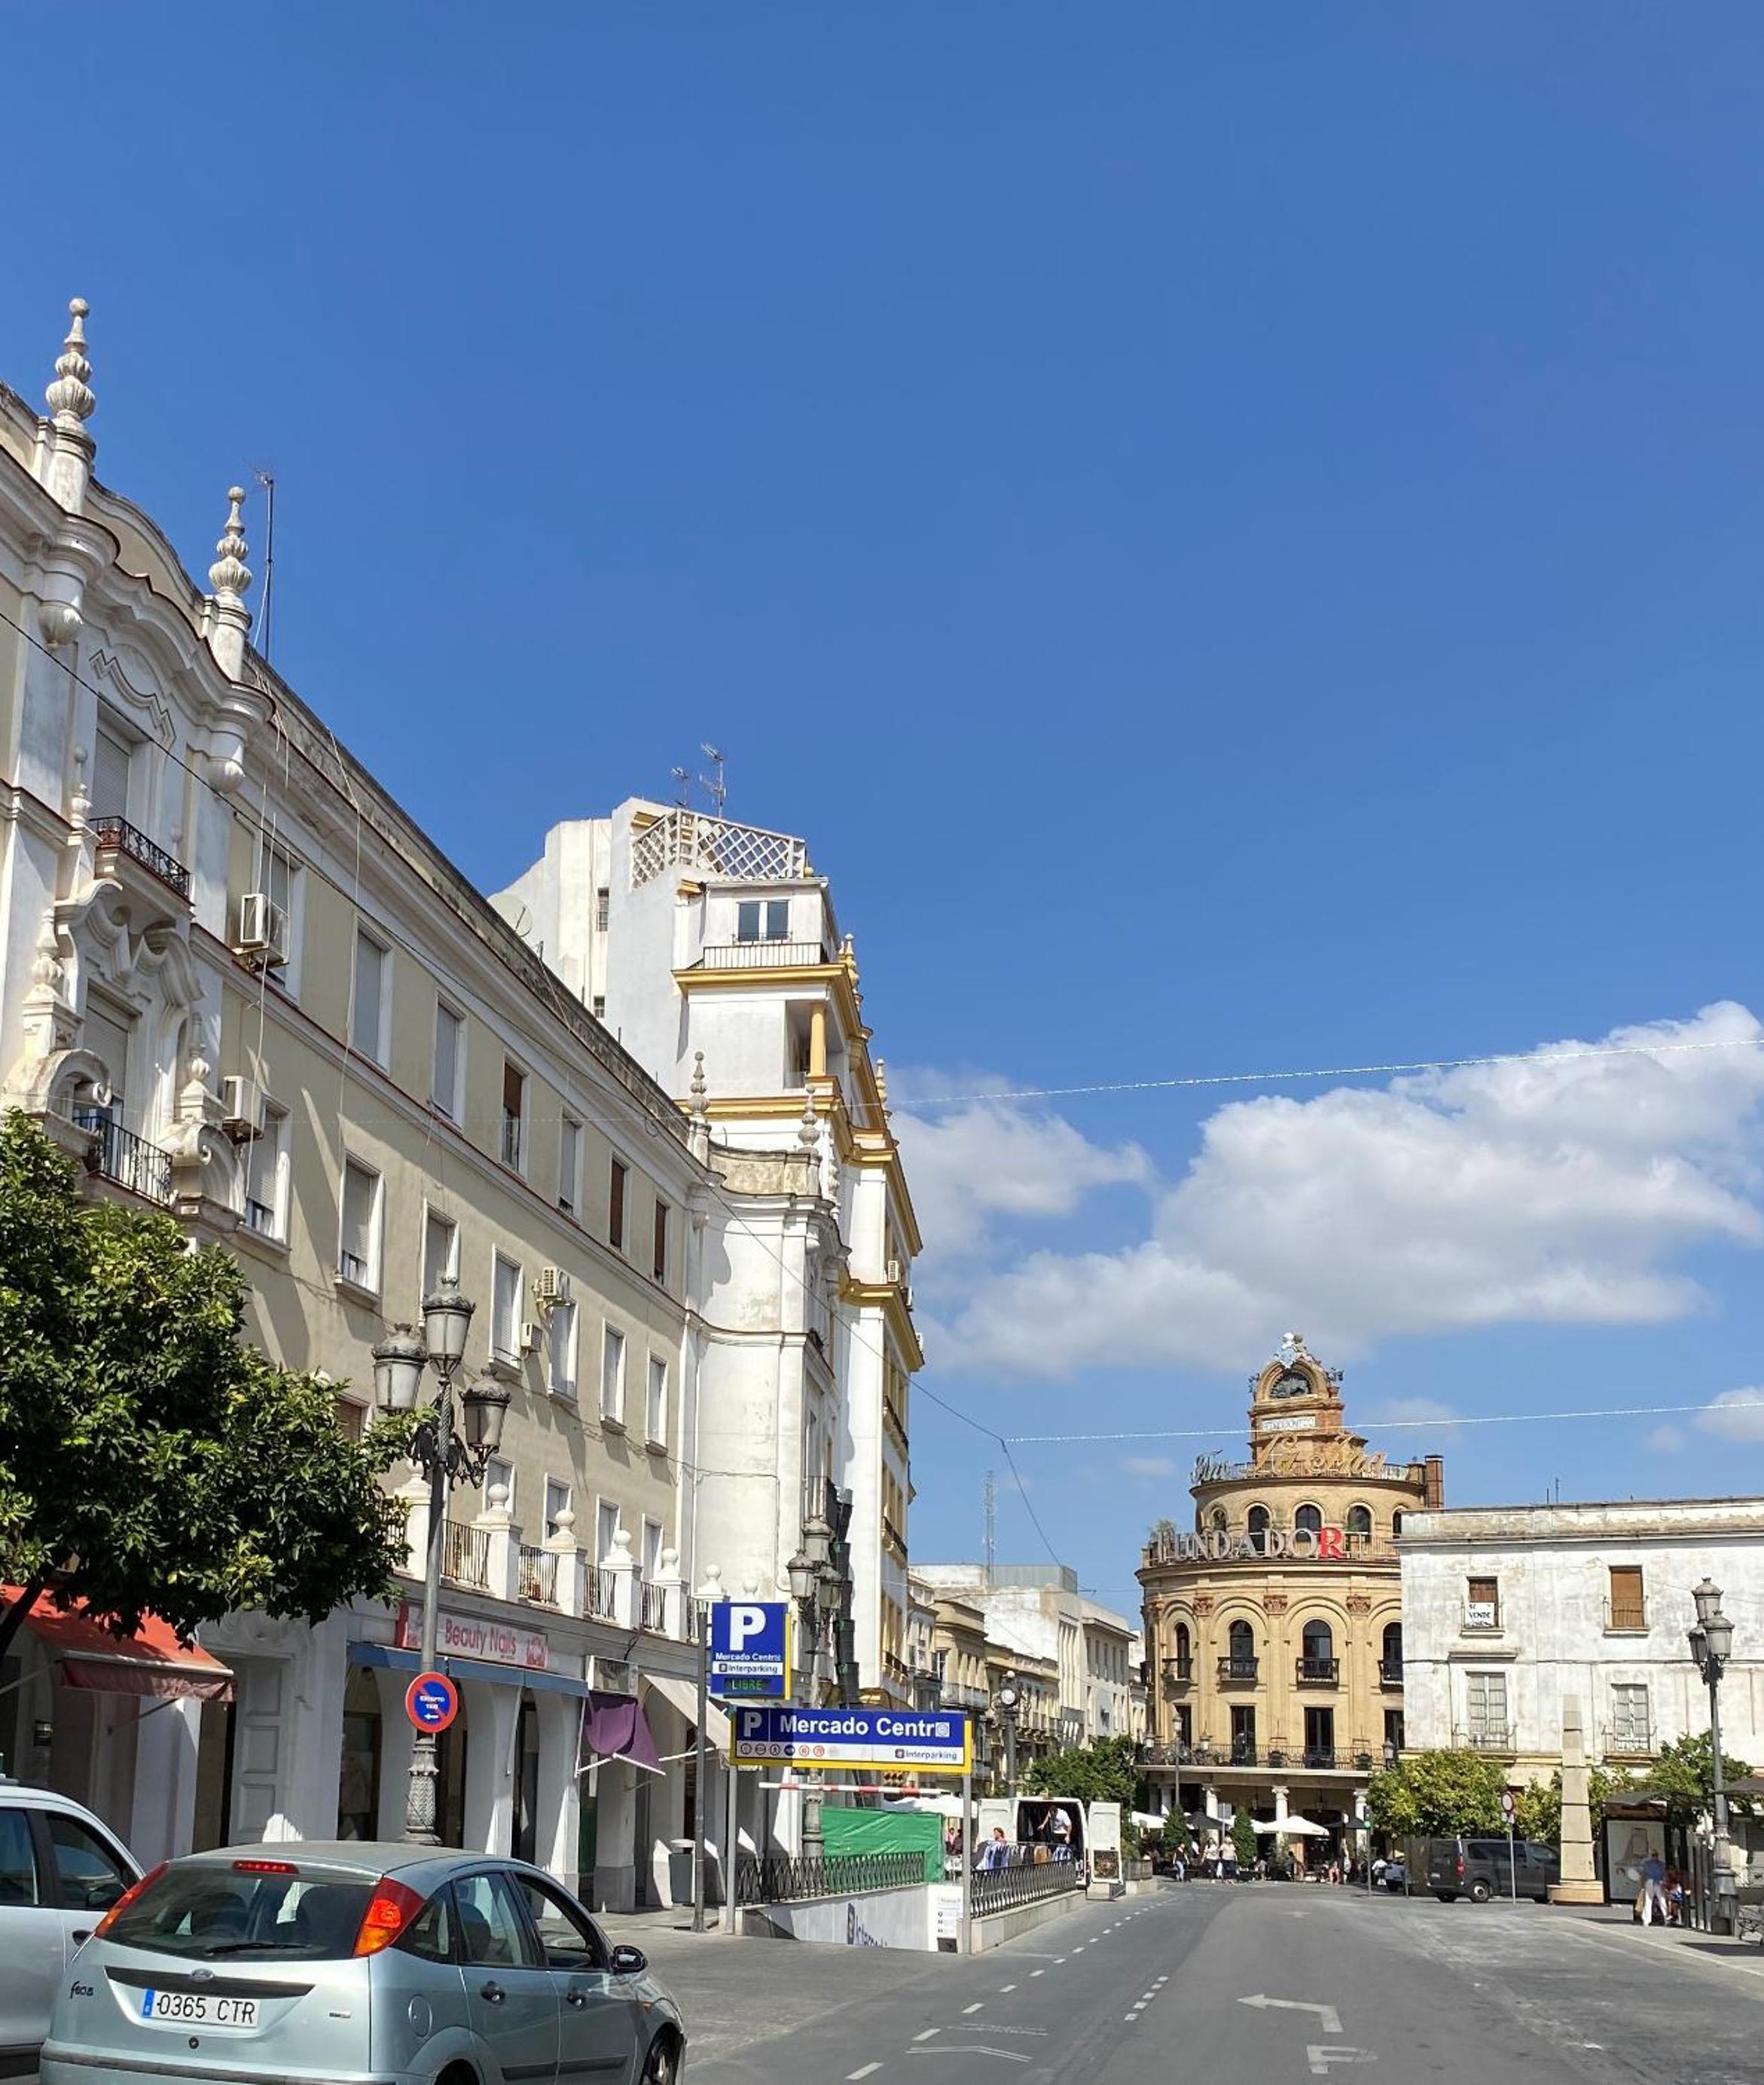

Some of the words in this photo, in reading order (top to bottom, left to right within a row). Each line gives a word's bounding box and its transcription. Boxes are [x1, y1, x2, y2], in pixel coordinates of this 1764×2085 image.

[1154, 1526, 1346, 1564] FUNDADOR
[445, 1618, 487, 1656] Beauty
[490, 1626, 517, 1656] Nails
[729, 1606, 767, 1651] P
[732, 1679, 763, 1690] LIBRE
[743, 1711, 762, 1738] P
[780, 1714, 869, 1735] Mercado
[159, 1994, 206, 2019] 0365
[217, 2000, 255, 2024] CTR
